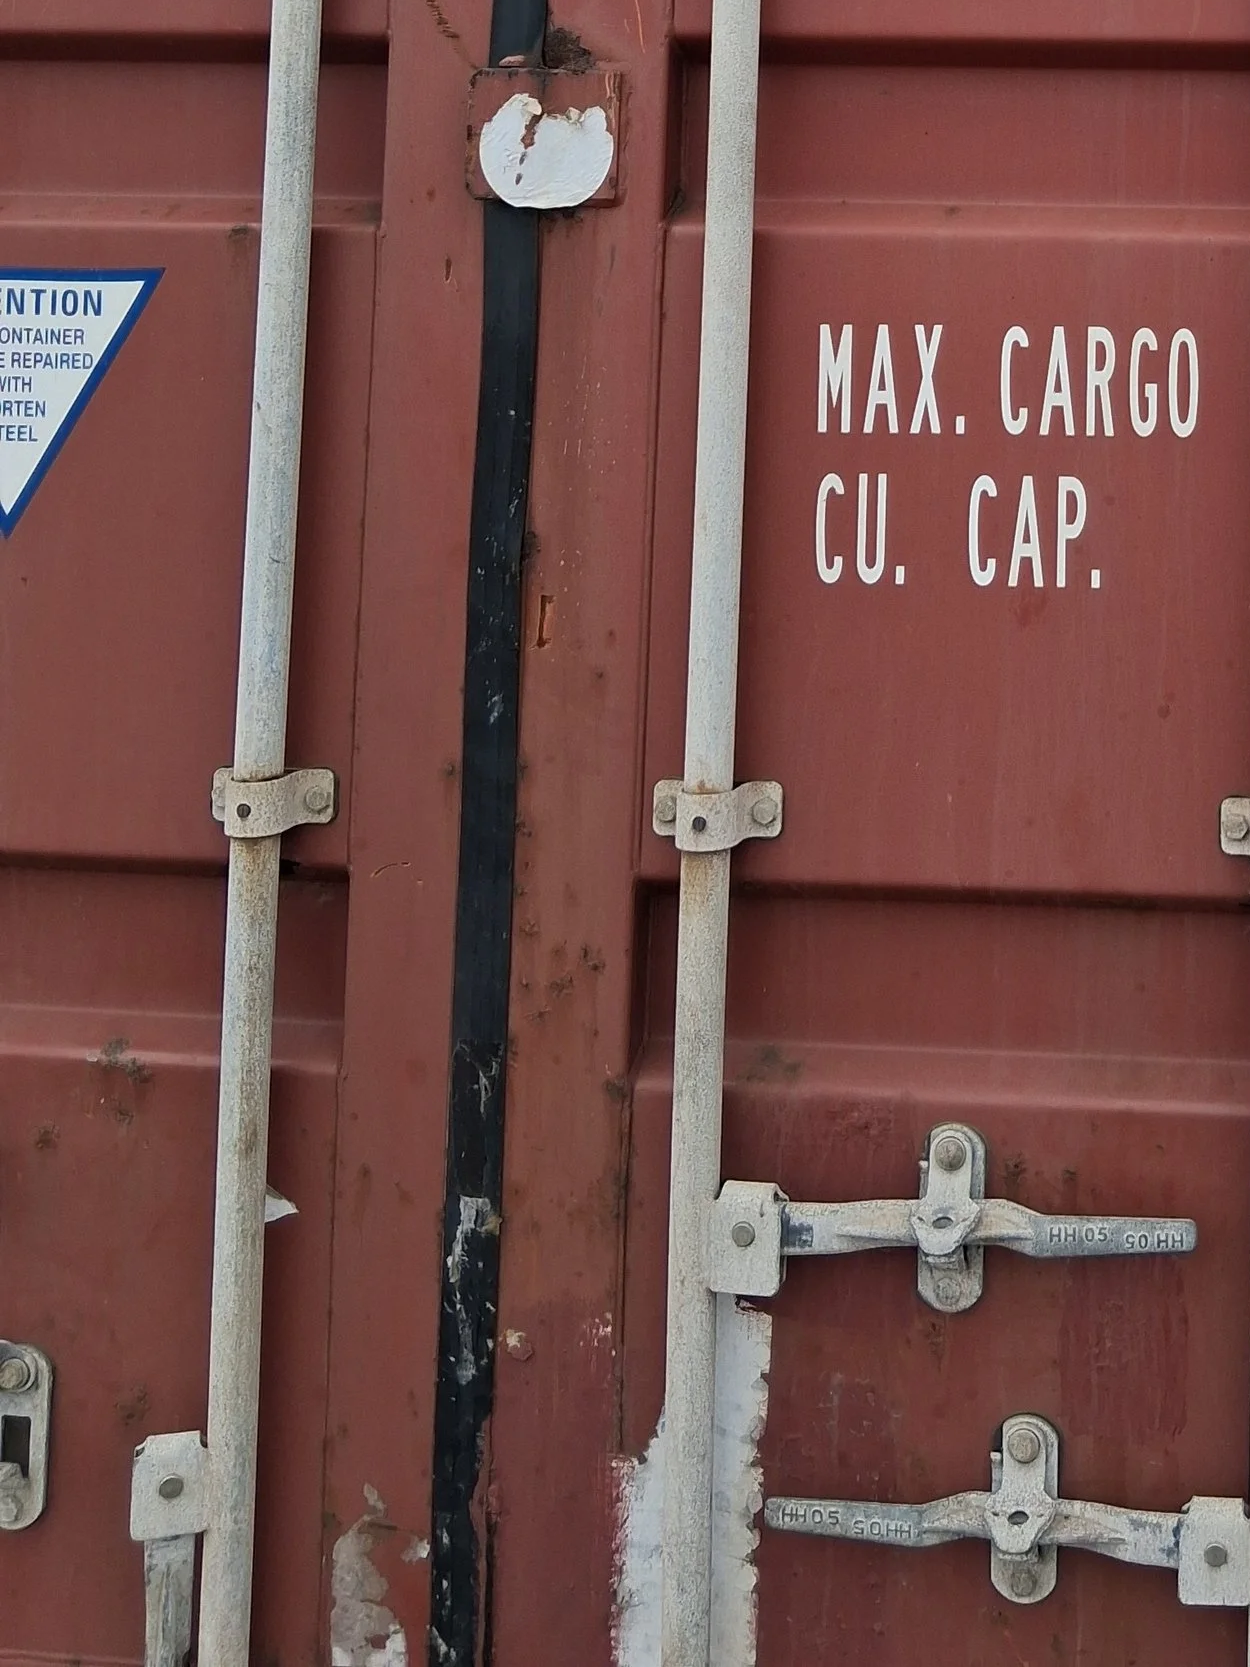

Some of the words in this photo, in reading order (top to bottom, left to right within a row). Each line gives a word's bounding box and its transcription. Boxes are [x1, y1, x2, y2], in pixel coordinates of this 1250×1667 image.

[0, 288, 103, 317] NTION
[11, 352, 93, 369] REPAIRED
[818, 324, 965, 435] MAX.
[1001, 326, 1199, 439] CARGO
[816, 473, 904, 585] CU.
[969, 475, 1100, 589] CAP.
